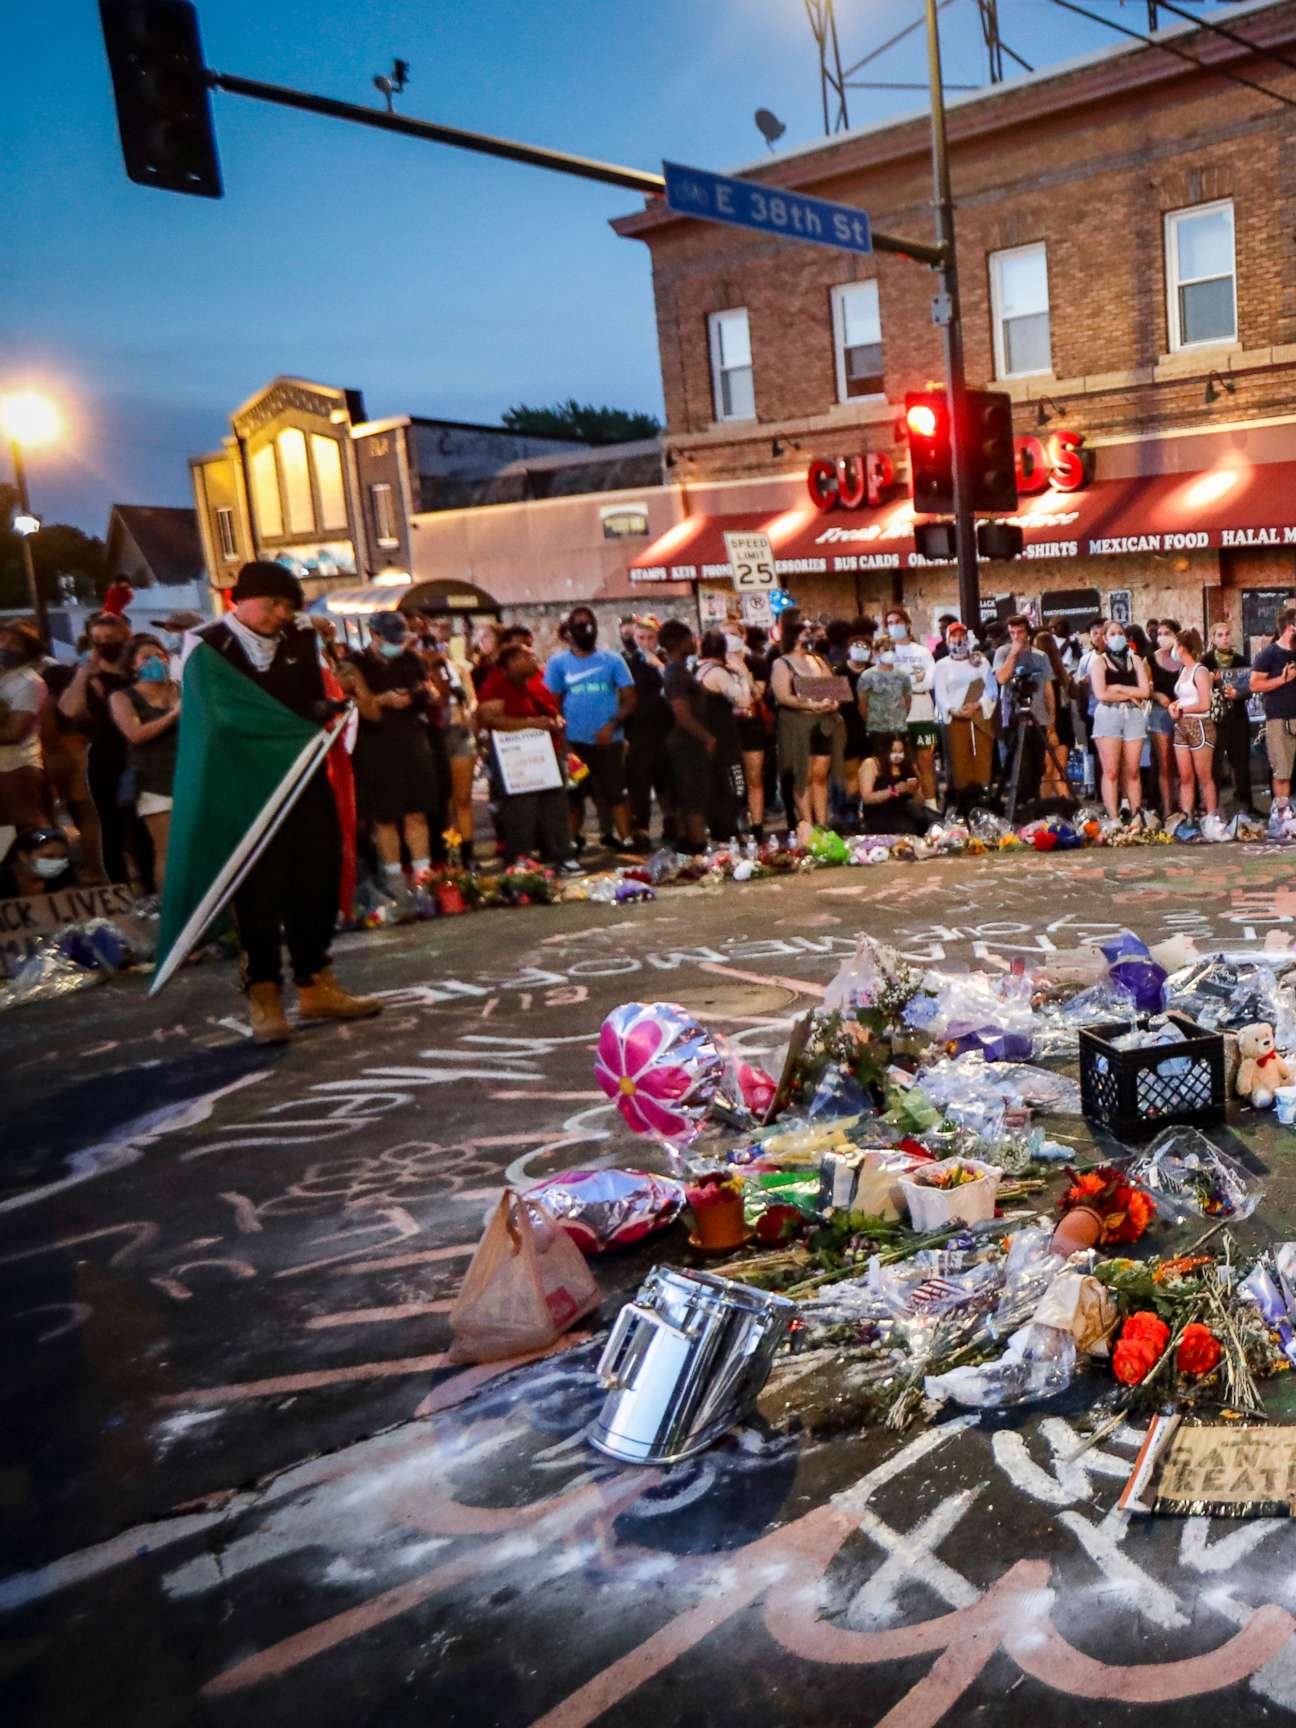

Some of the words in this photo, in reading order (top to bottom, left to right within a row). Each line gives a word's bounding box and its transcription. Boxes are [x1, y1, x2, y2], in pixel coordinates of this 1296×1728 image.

[716, 185, 735, 214] E
[750, 194, 823, 235] 38th
[832, 213, 864, 246] St
[808, 452, 895, 511] CUP
[731, 538, 768, 549] SPEED
[737, 550, 766, 562] LIMIT
[834, 556, 858, 571] BUS
[859, 553, 900, 569] CARDS
[1089, 536, 1161, 555] MEXICAN
[1164, 532, 1209, 550] FOOD
[1221, 528, 1281, 546] HALAL
[737, 563, 773, 585] 25
[47, 884, 134, 922] LIVES
